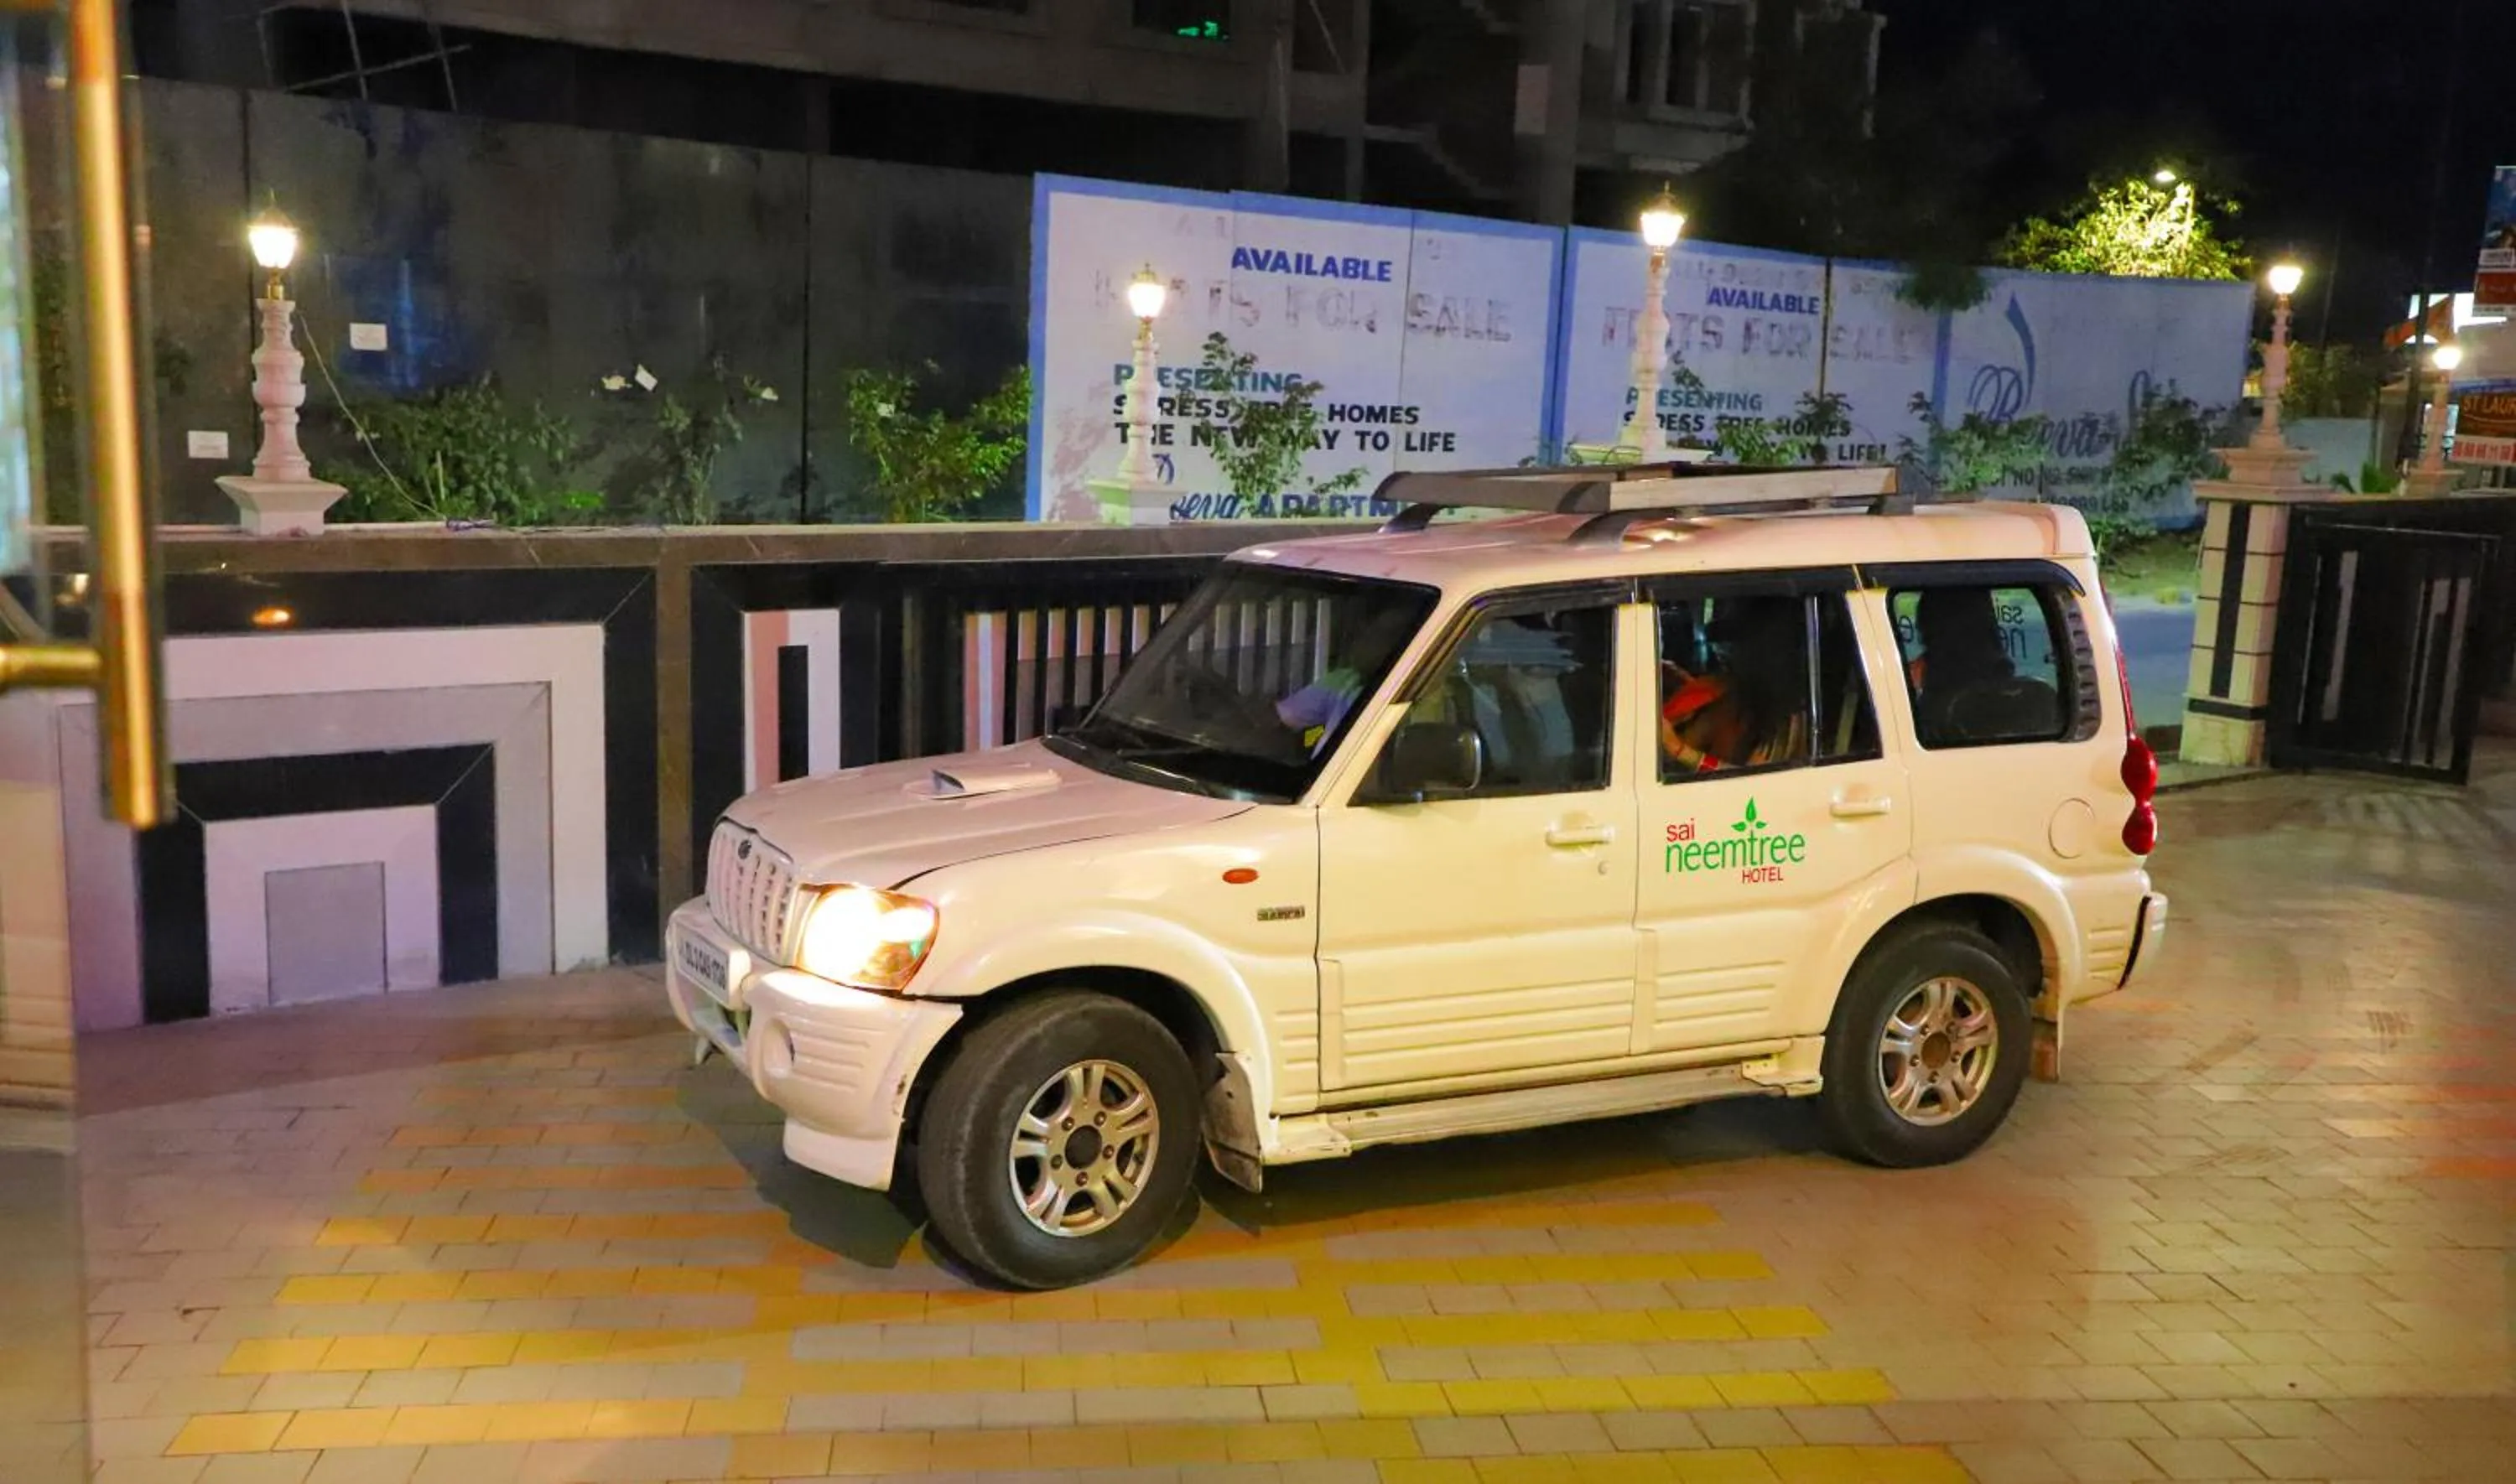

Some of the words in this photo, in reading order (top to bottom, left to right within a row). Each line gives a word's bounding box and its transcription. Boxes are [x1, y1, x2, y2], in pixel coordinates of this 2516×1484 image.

[1230, 246, 1393, 283] AVAILABLE
[1706, 287, 1820, 315] AVAILABLE
[1113, 393, 1230, 419] SRESS
[1328, 403, 1421, 425] HOMES
[1625, 387, 1764, 412] PESENTING
[1114, 423, 1174, 446] TE
[1354, 430, 1390, 451] TO
[1405, 432, 1456, 452] LIFE
[1666, 817, 1695, 842] sai
[1665, 829, 1806, 873] neemtree
[1741, 865, 1784, 885] HOTEL
